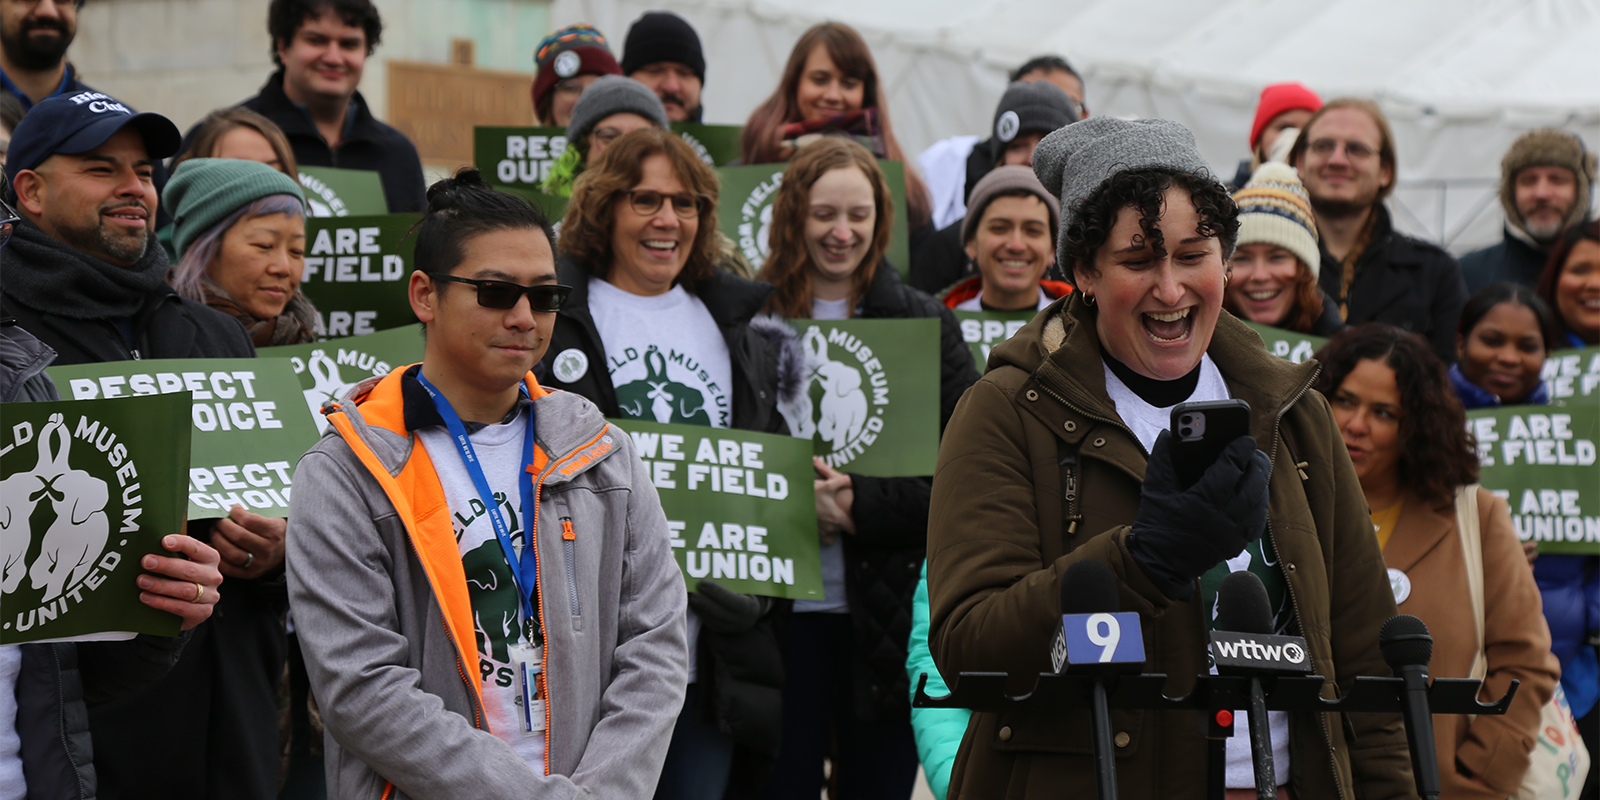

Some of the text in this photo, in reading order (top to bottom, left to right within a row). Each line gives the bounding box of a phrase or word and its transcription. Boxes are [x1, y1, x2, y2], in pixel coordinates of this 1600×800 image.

[298, 173, 350, 217] MUSE
[310, 227, 380, 255] ARE
[301, 254, 404, 283] FIELD
[313, 311, 377, 336] ARE
[828, 327, 889, 405] MUSEUM
[69, 371, 256, 401] RESPECT
[669, 349, 728, 427] MUSEUM
[1507, 413, 1574, 440] ARE
[630, 431, 764, 469] WE ARE
[1502, 439, 1597, 466] FIELD
[74, 415, 142, 533] MUSEUM
[189, 461, 292, 492] PECT
[687, 463, 789, 500] FIELD
[1520, 488, 1582, 515] ARE
[697, 522, 769, 553] ARE
[1513, 514, 1600, 542] UNION
[686, 551, 794, 585] UNION
[16, 551, 121, 632] UNITED
[1086, 613, 1121, 663] 9
[1215, 639, 1281, 661] wttw
